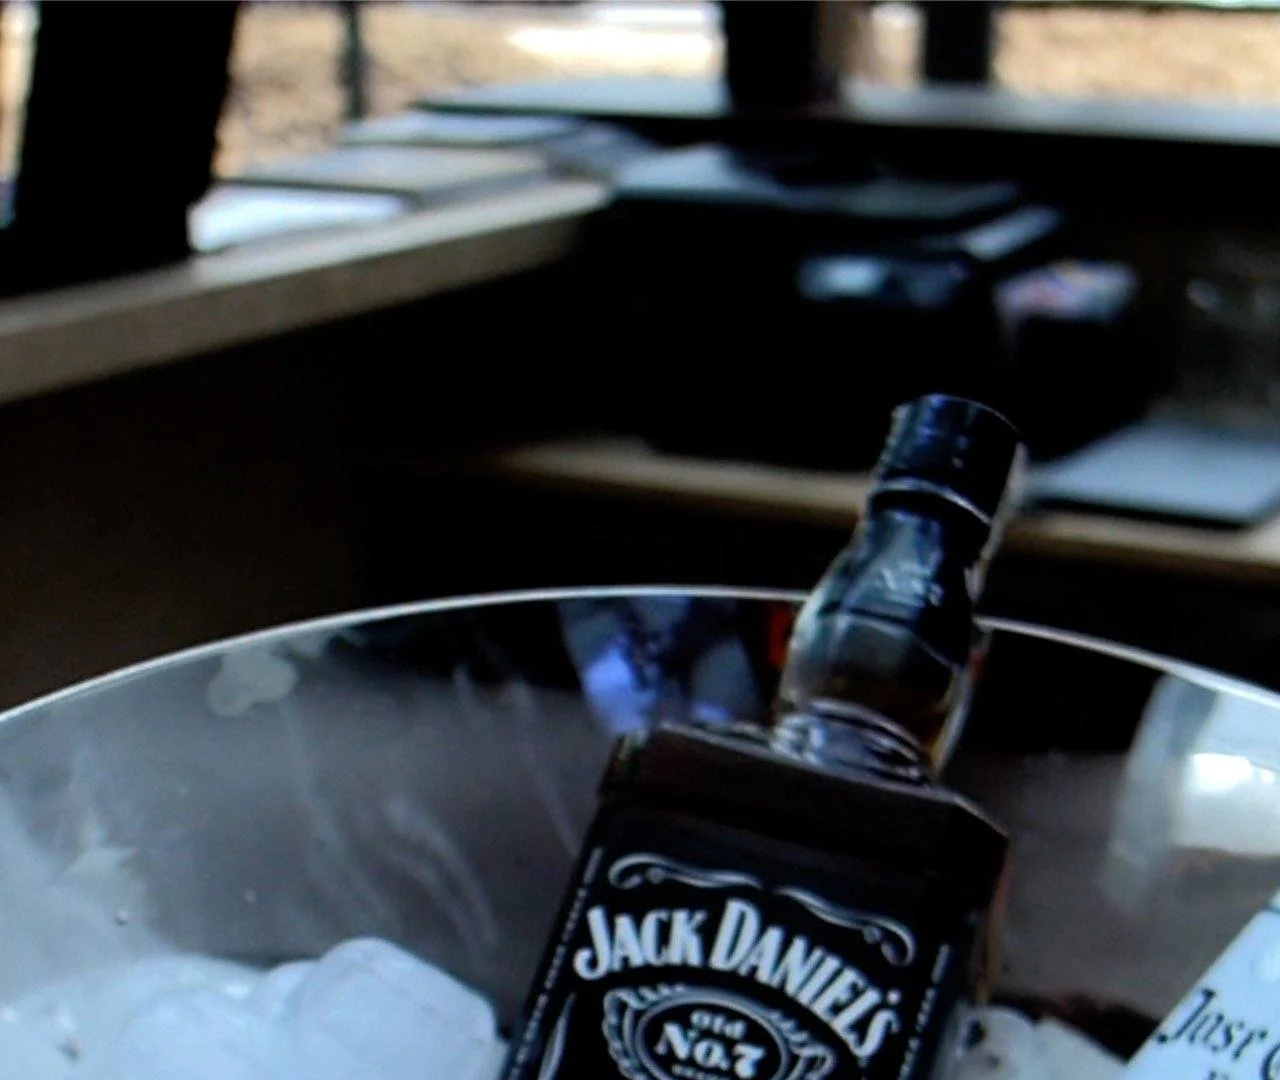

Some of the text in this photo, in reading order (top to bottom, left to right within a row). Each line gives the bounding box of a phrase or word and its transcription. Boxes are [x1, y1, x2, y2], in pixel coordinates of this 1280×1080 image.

[573, 898, 902, 1058] JACK DANIEL'S
[689, 1009, 747, 1040] Old
[1156, 987, 1269, 1062] Jose
